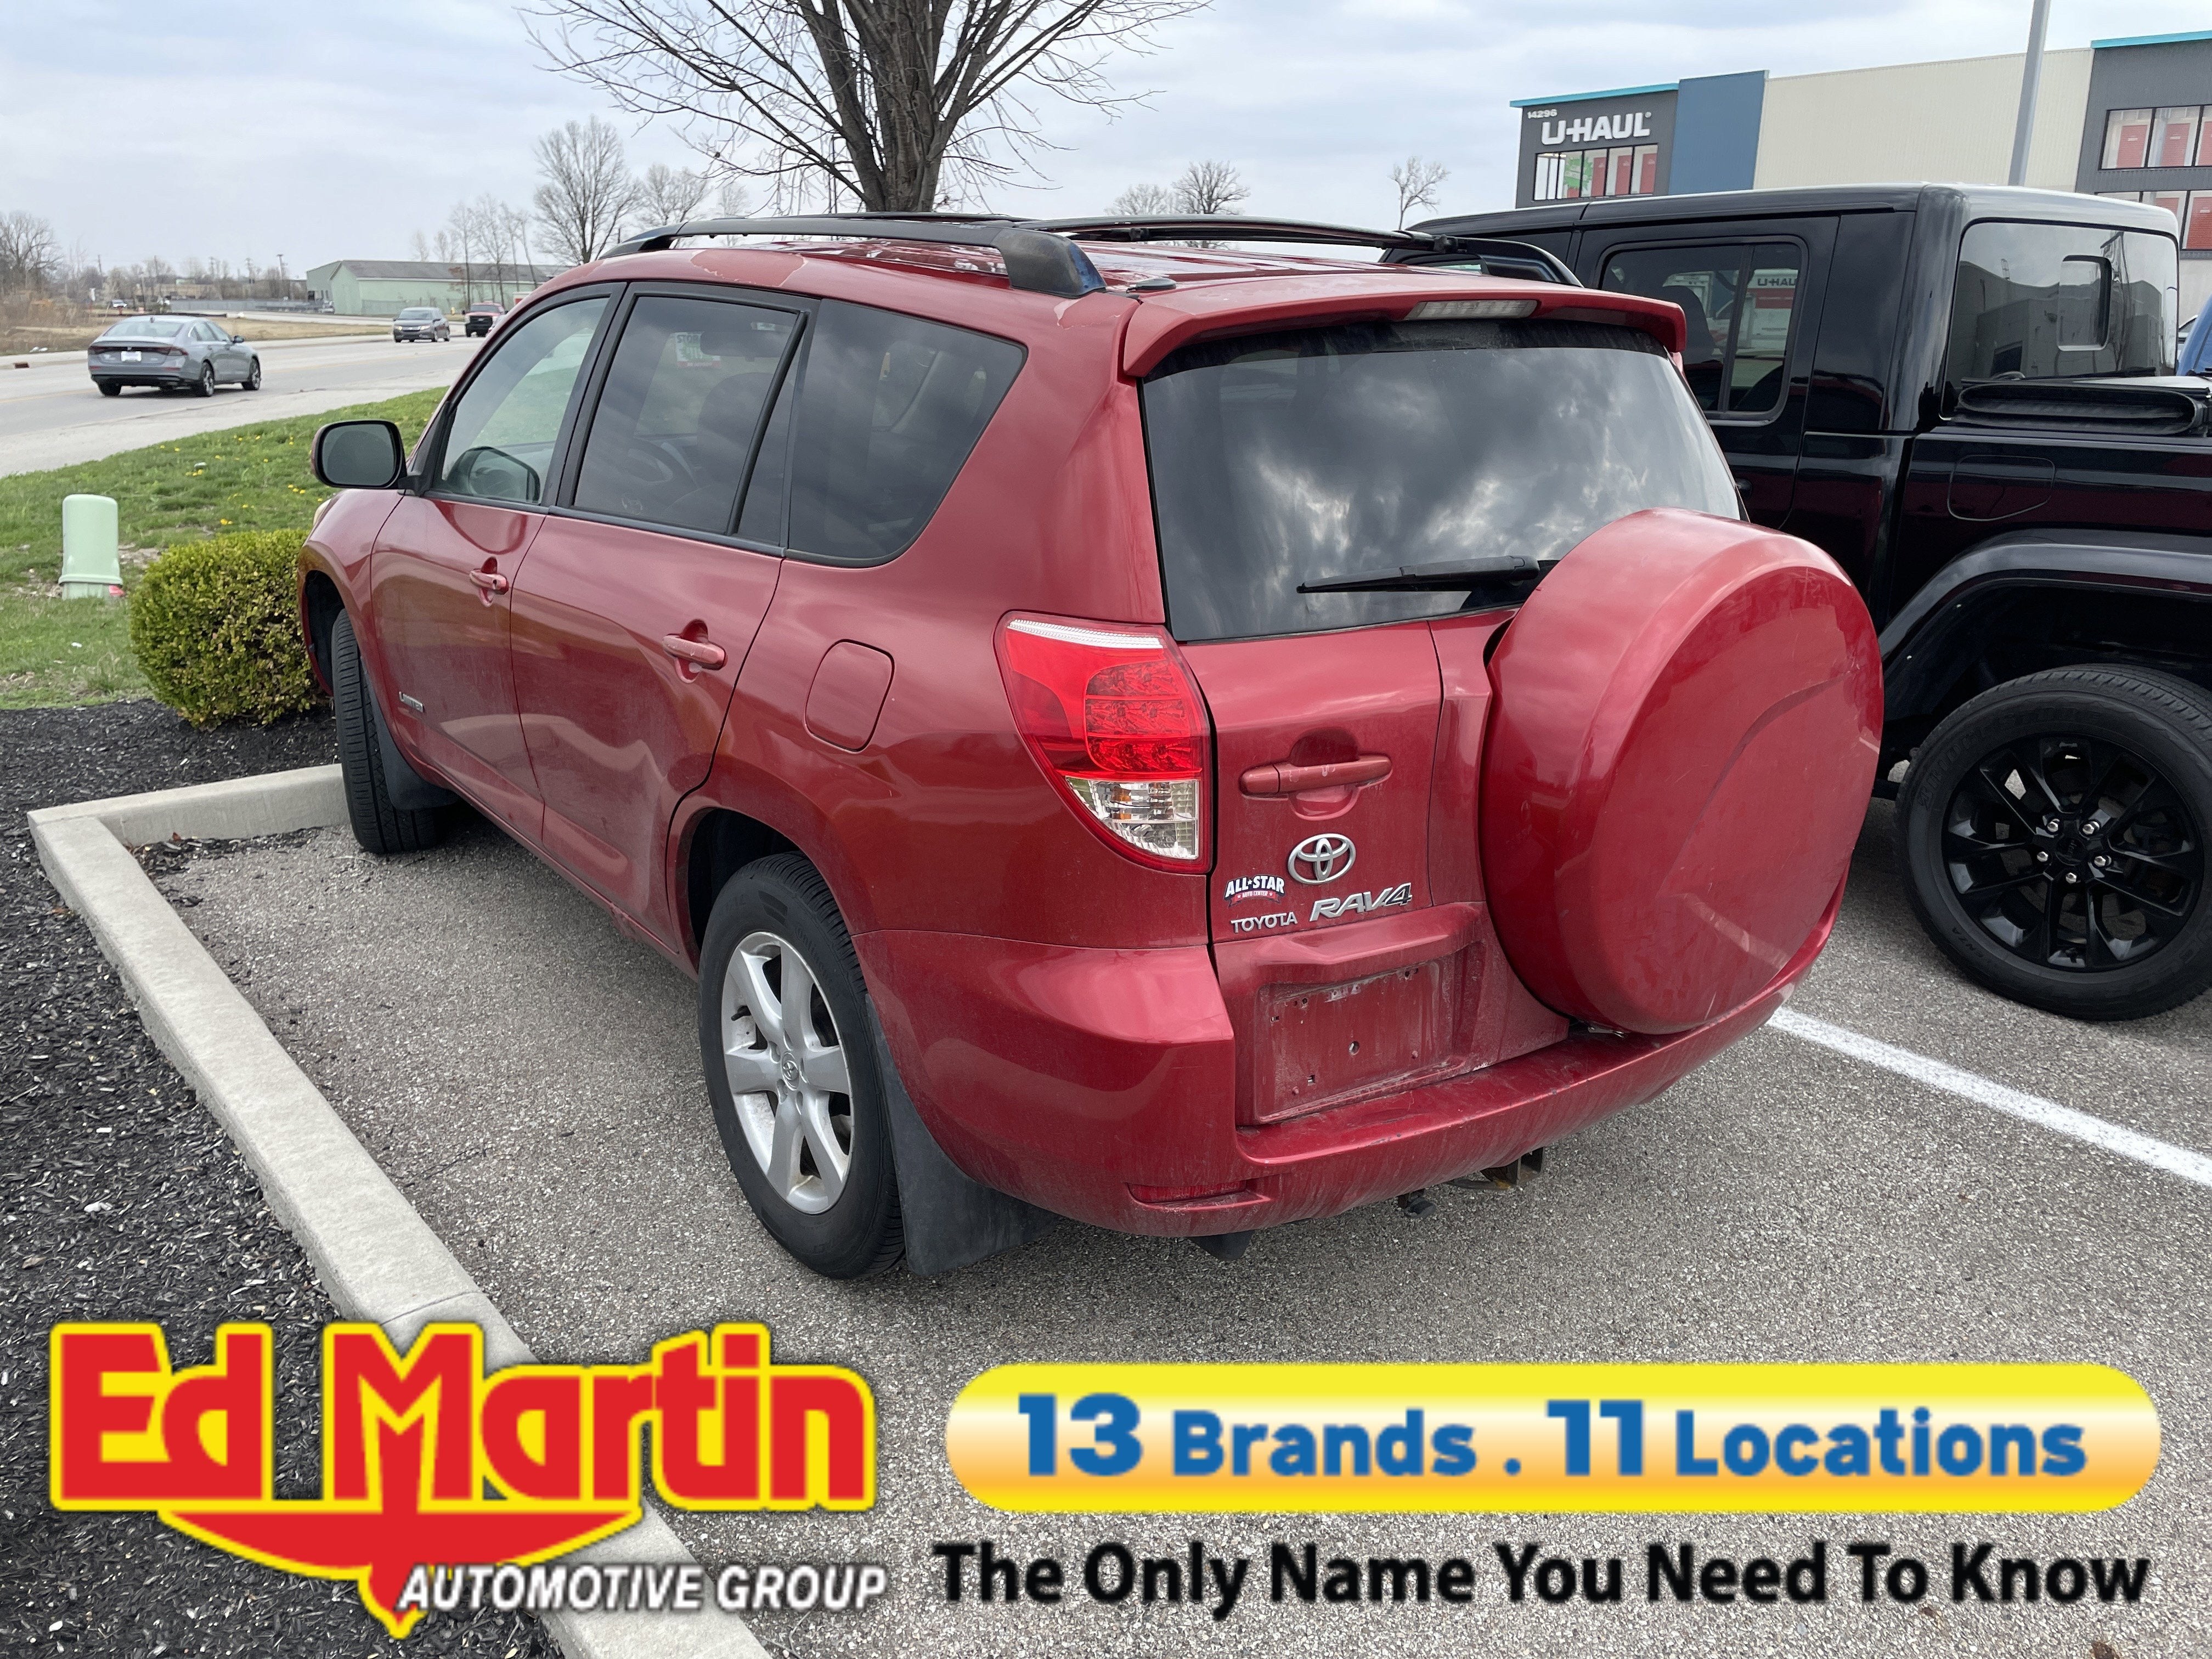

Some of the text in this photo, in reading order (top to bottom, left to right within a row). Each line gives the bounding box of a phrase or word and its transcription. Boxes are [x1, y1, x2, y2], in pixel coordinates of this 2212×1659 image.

[1527, 109, 1558, 119] 14296
[1542, 112, 1651, 145] U-HAUL
[1757, 277, 1797, 286] U-HAU
[1309, 882, 1413, 922] RAV4
[1231, 911, 1298, 933] TOYOTA
